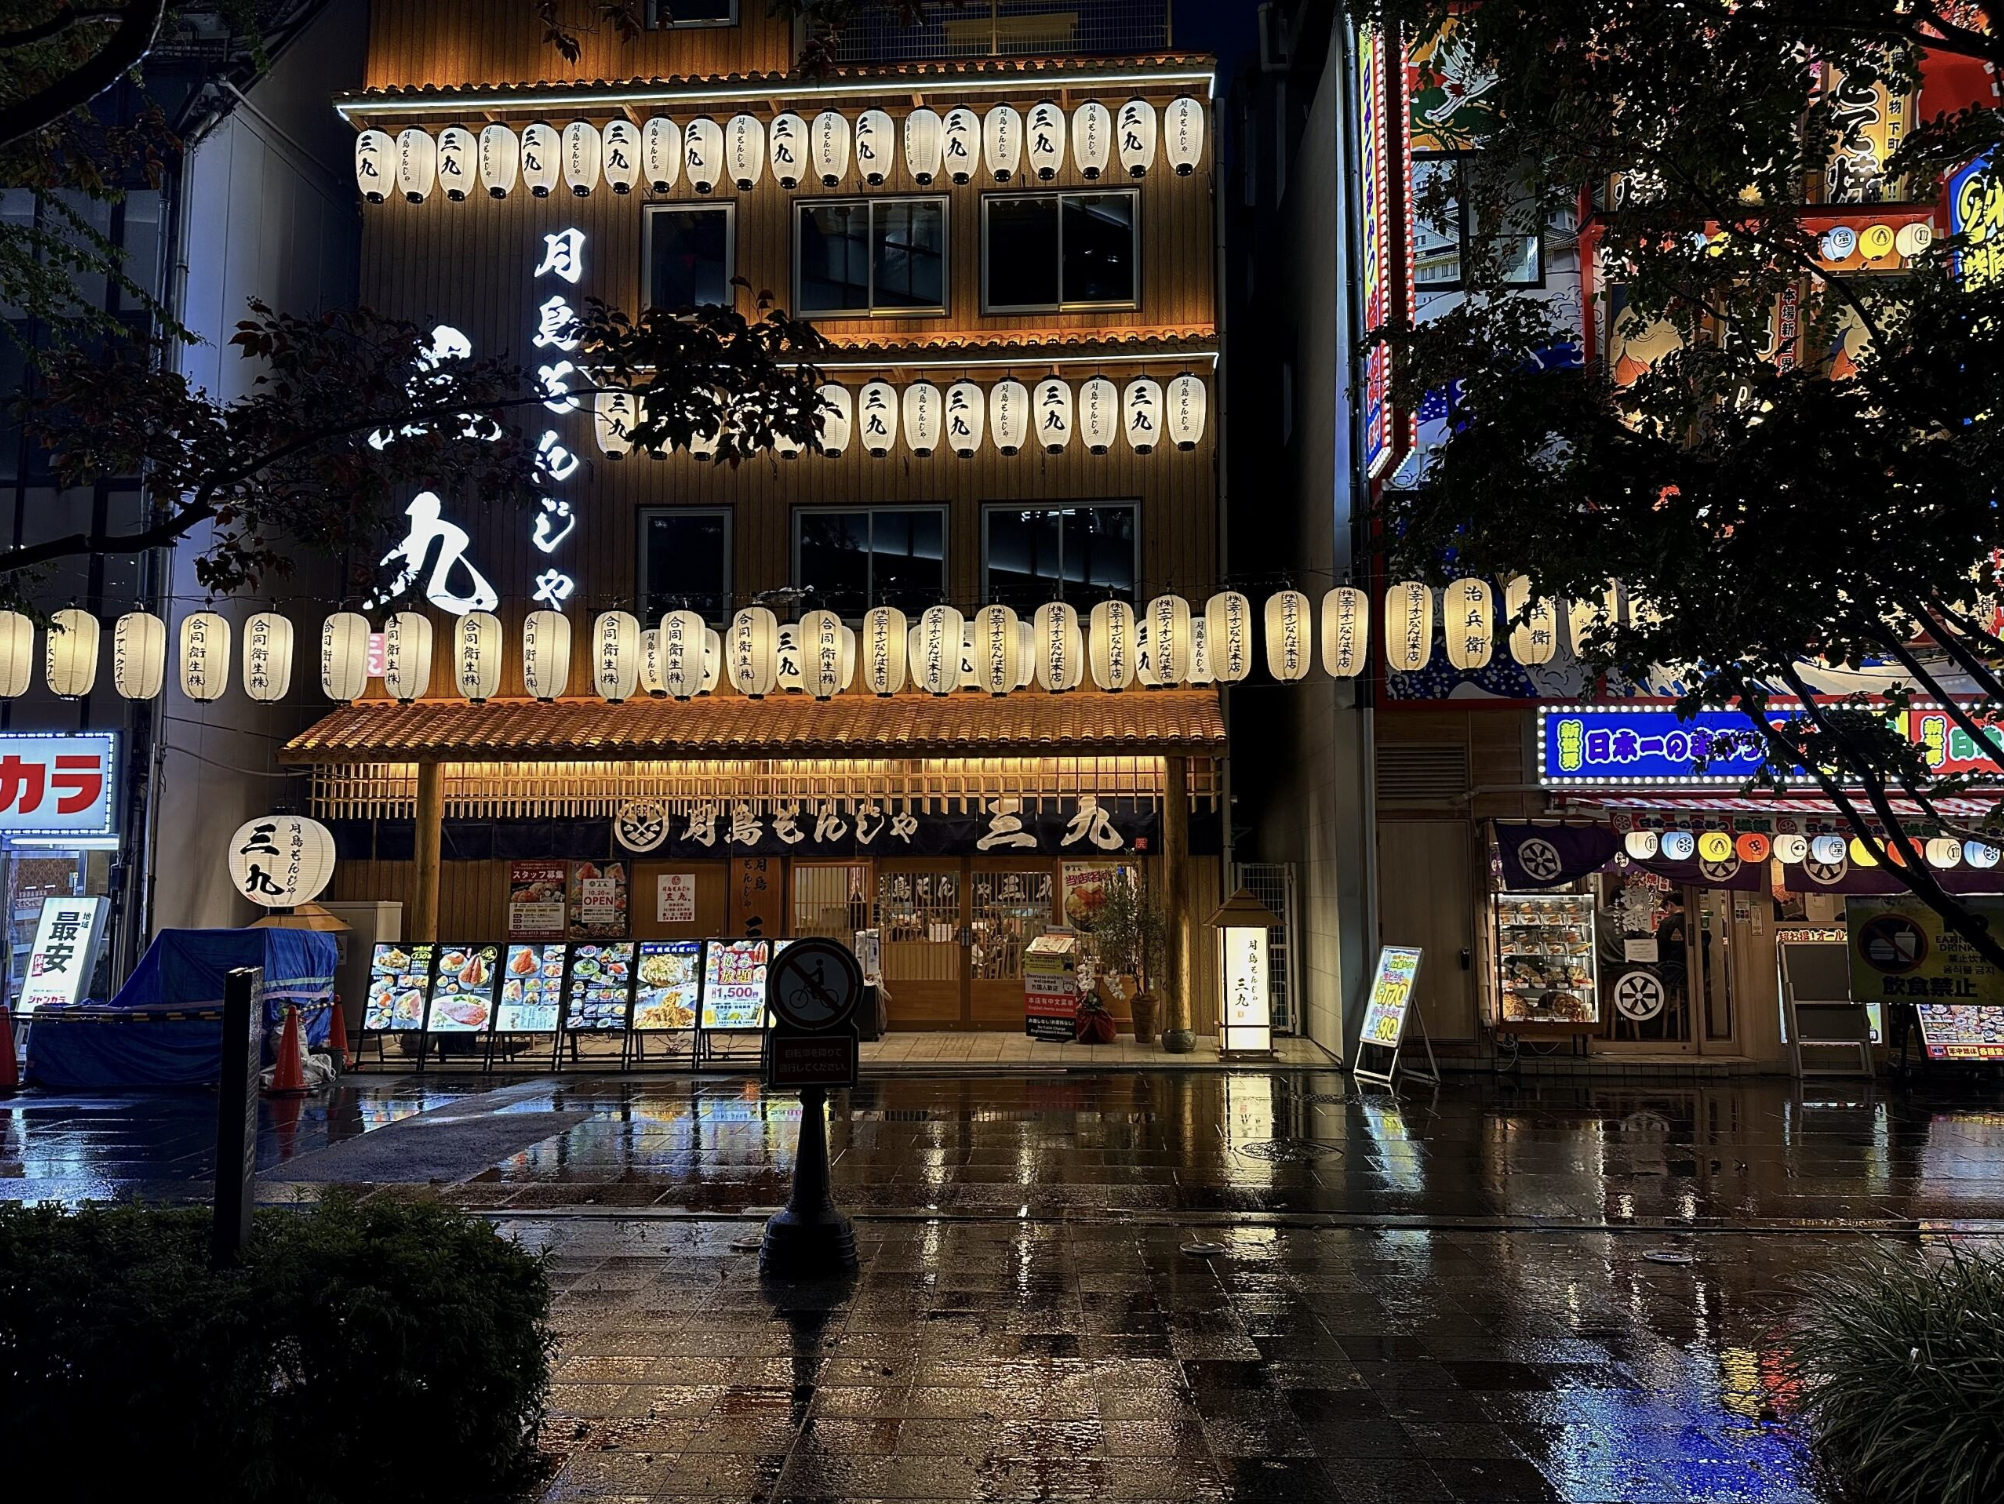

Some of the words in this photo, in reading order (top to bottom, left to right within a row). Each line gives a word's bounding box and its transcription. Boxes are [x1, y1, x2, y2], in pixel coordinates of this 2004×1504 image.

[523, 128, 542, 172] 三九
[608, 125, 629, 169] 三九
[686, 122, 704, 167] 三九
[774, 119, 794, 164] 三九
[857, 117, 875, 161] 三九
[947, 113, 967, 158] 三九
[1034, 109, 1054, 155] 三九
[1123, 107, 1143, 153] 三九
[359, 134, 378, 178] 三九
[440, 133, 462, 177] 三九
[532, 227, 586, 611] 月島もんじゃ
[865, 389, 887, 435] 三九
[949, 390, 971, 436] 三九
[1043, 386, 1065, 431] 三九
[1131, 386, 1153, 431] 三九
[1530, 601, 1551, 645] 兵衛
[777, 632, 800, 676] 三九
[681, 803, 918, 847] 月島もんじゃ
[976, 796, 1124, 850] 三九
[240, 823, 285, 895] 三九
[287, 823, 303, 894] 月島もんじゃ
[512, 870, 564, 879] スタッフ募集
[755, 858, 767, 891] 月島
[584, 896, 613, 905] OPEN
[42, 911, 80, 974] 最安
[1235, 978, 1249, 1007] 三九
[1248, 940, 1258, 1000] 月島もんじゃ
[1883, 977, 1979, 998] 飲食禁止
[784, 1048, 842, 1058] 自転車を降りて
